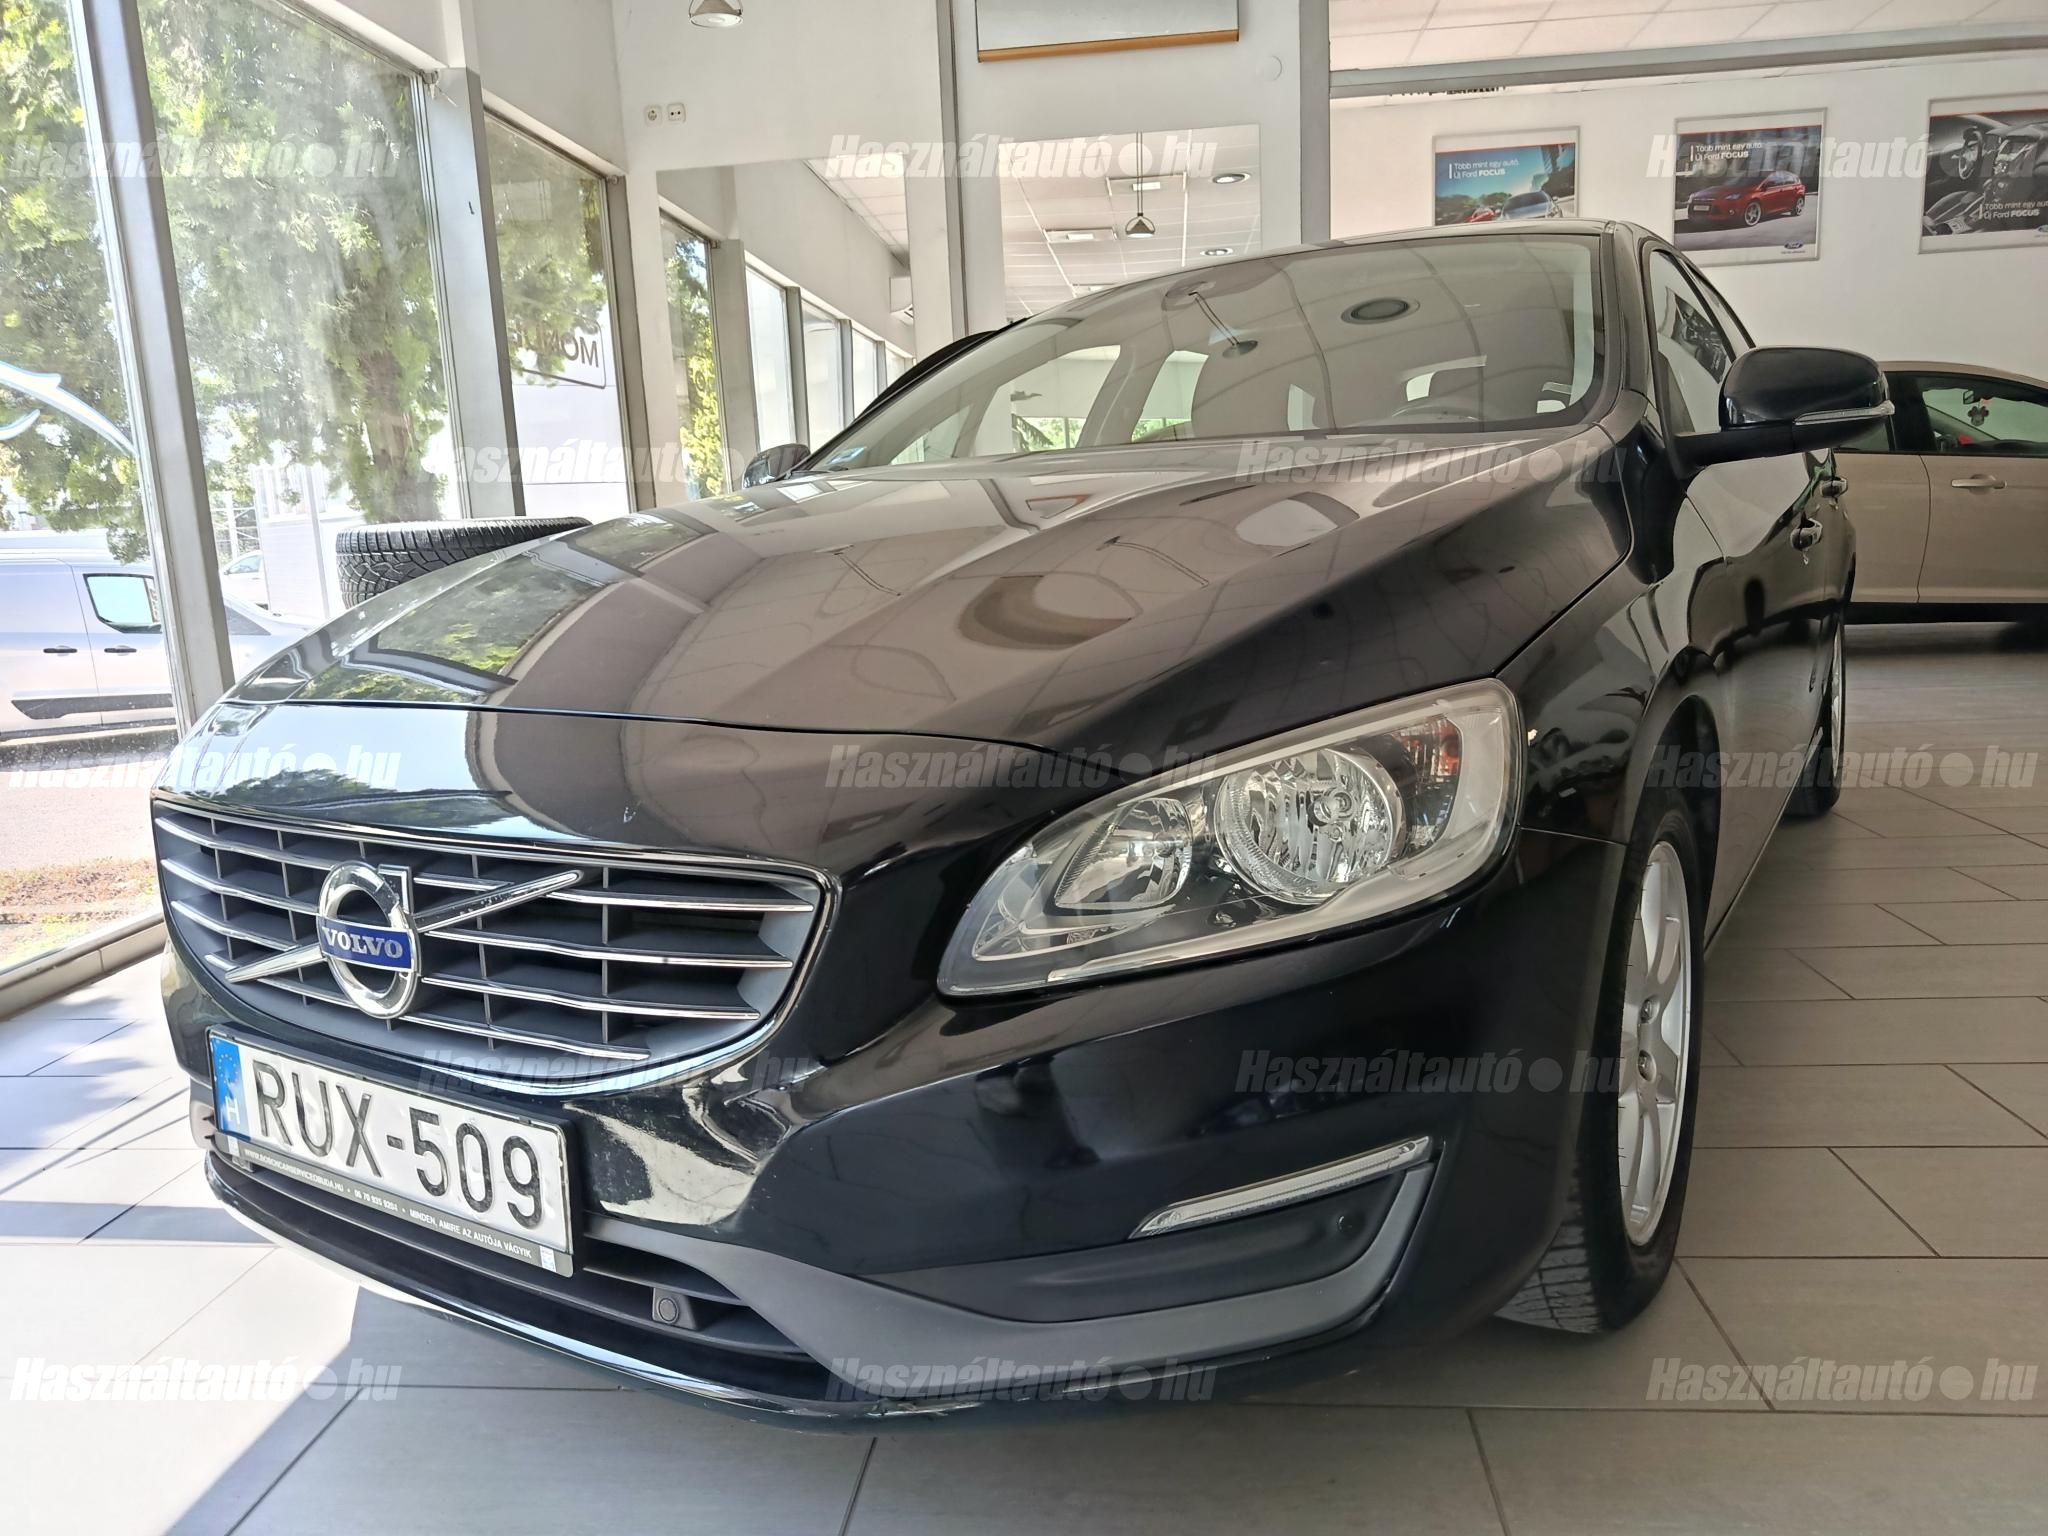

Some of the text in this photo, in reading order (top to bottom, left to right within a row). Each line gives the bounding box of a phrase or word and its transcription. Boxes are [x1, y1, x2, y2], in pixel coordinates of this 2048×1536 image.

[1720, 151, 1748, 160] FOCUS
[1461, 170, 1478, 178] Ford
[1478, 168, 1506, 177] FOCUS
[1992, 210, 2010, 218] Ford
[2010, 208, 2040, 217] FOCUS
[321, 926, 403, 959] VOLVO
[225, 1096, 241, 1125] H
[252, 1059, 542, 1229] RUX-509
[409, 1208, 438, 1229] MINDEN,
[438, 1217, 461, 1235] AMIRE
[462, 1226, 472, 1238] AZ
[473, 1230, 503, 1250] AUTÓJA
[503, 1240, 532, 1259] VÁGYIK
